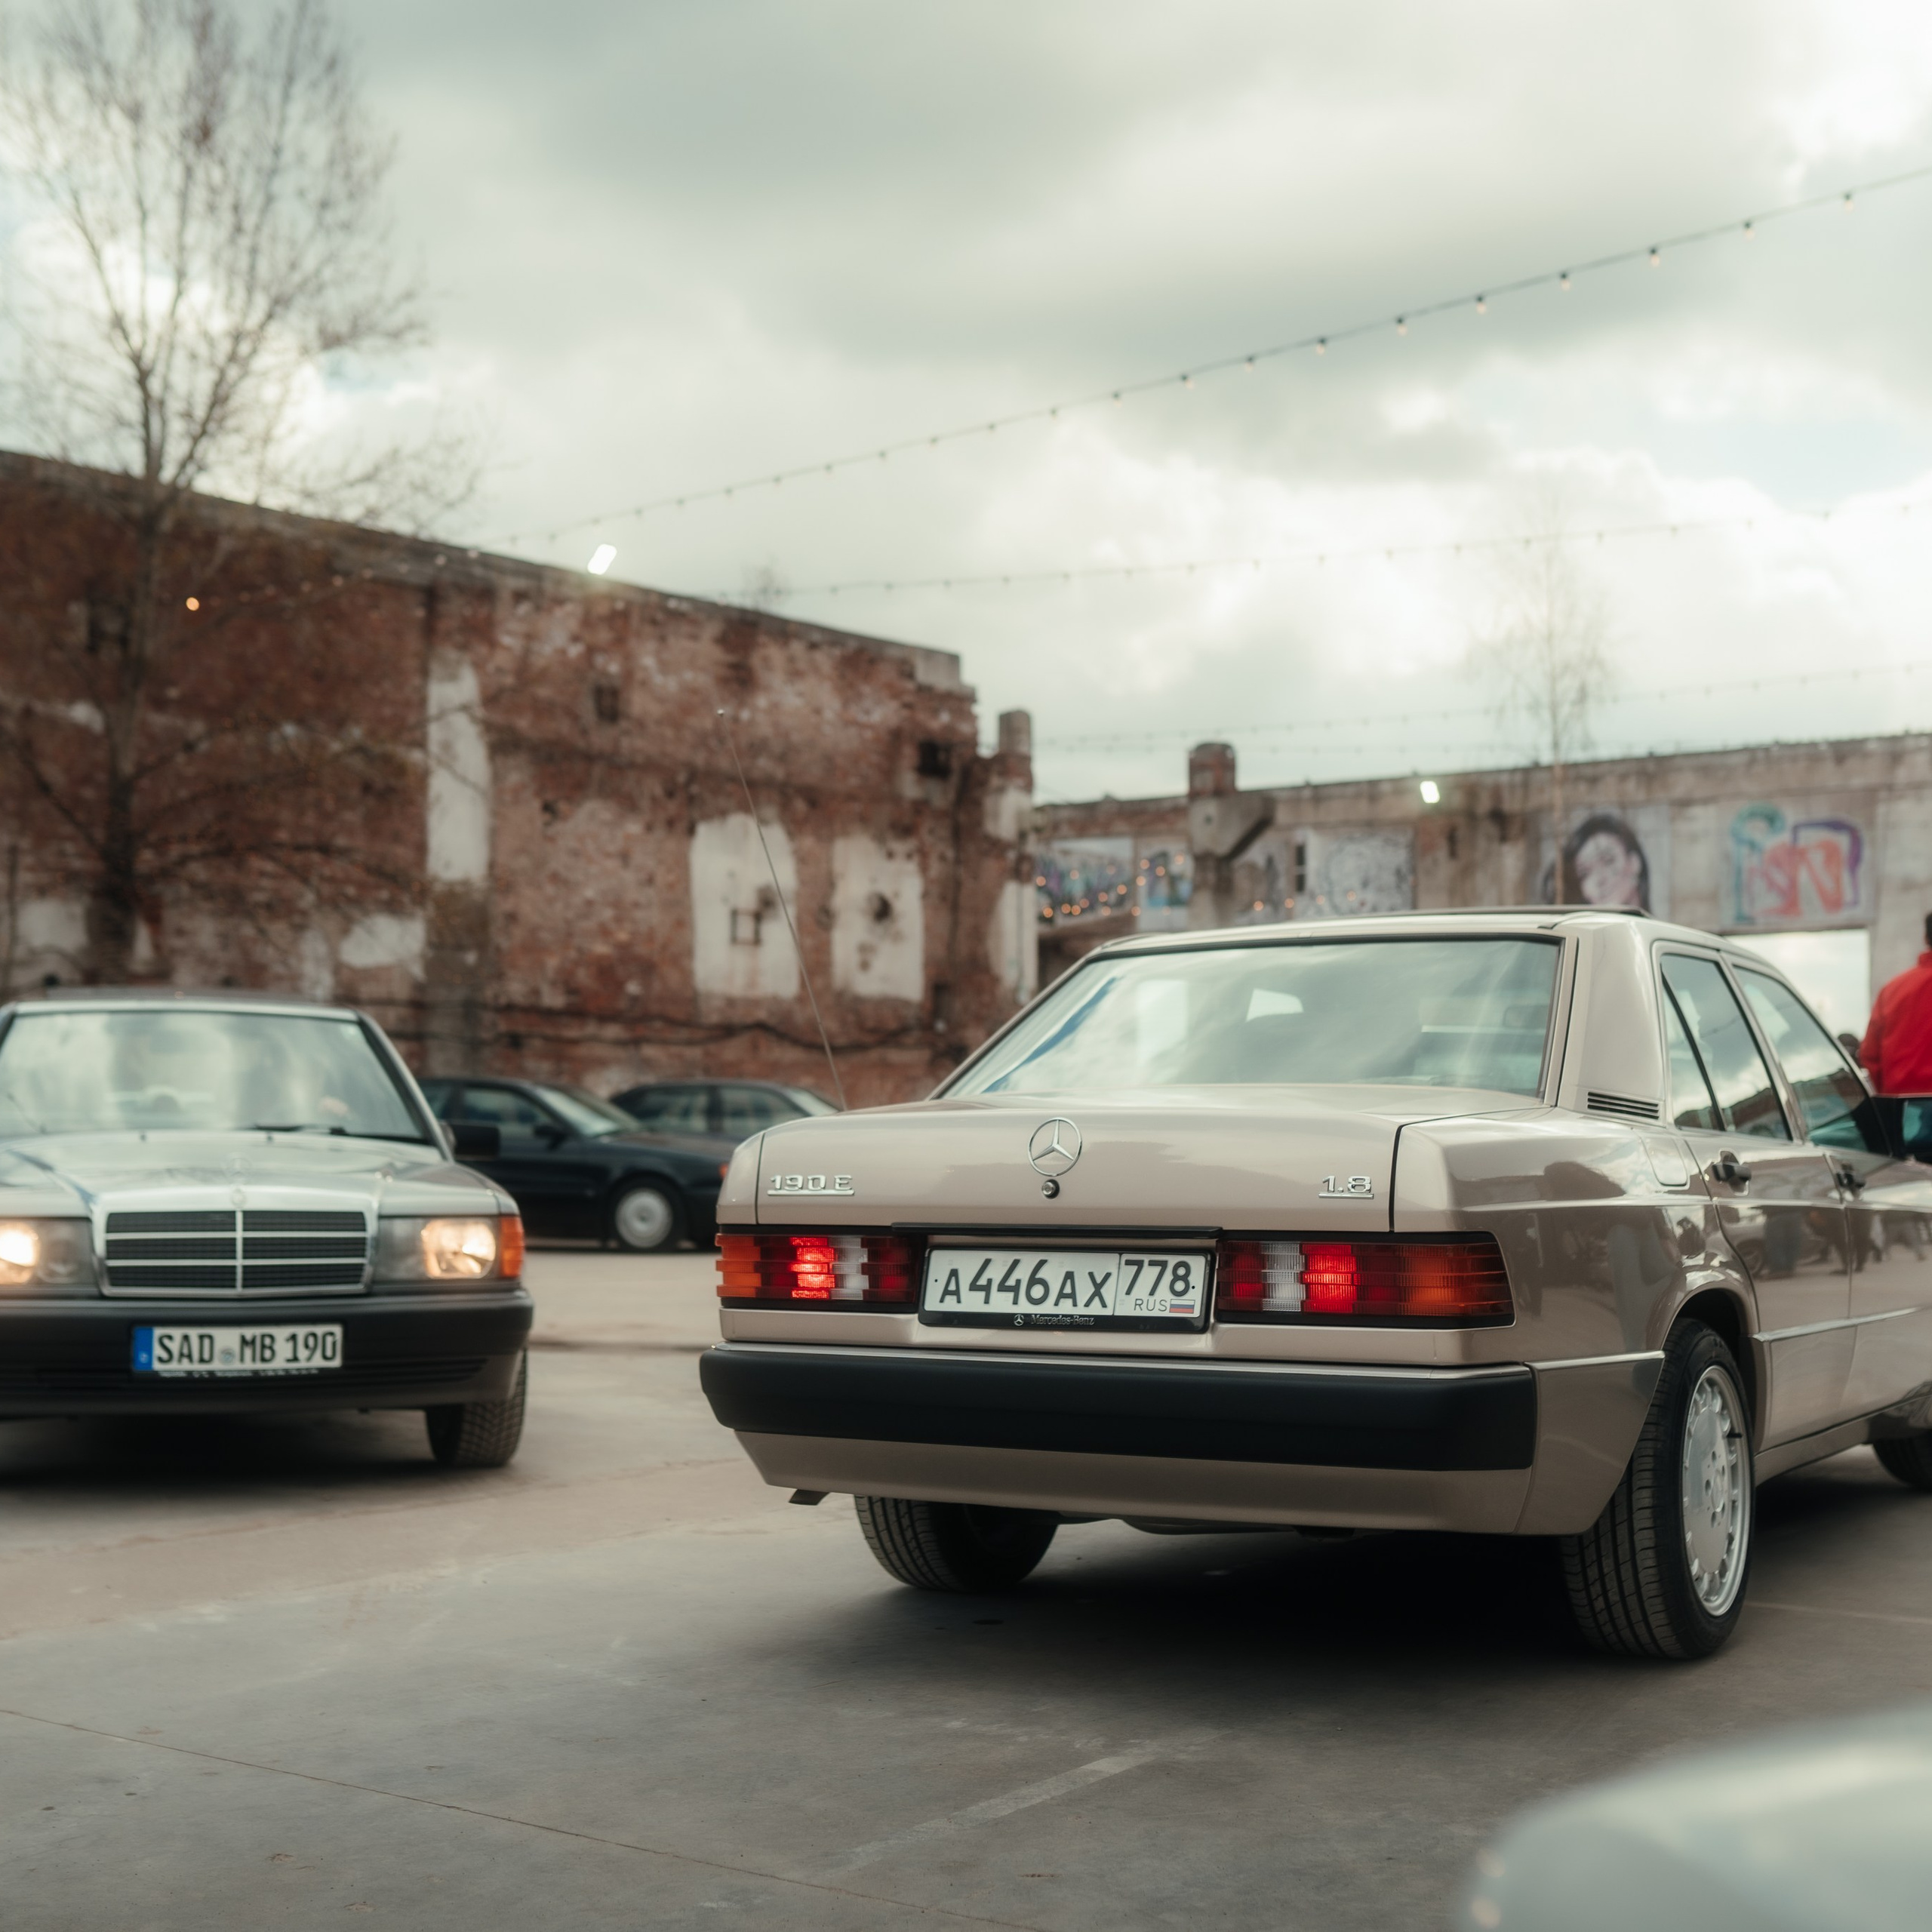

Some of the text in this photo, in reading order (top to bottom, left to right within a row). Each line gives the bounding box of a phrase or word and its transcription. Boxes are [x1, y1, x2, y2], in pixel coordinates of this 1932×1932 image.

[770, 1175, 852, 1191] 190 E
[1322, 1175, 1371, 1193] 1.8
[1124, 1260, 1191, 1297] 778
[1134, 1298, 1168, 1312] RUS
[1030, 1314, 1095, 1325] Mercedes-Benz
[156, 1331, 337, 1364] SAD MB 190
